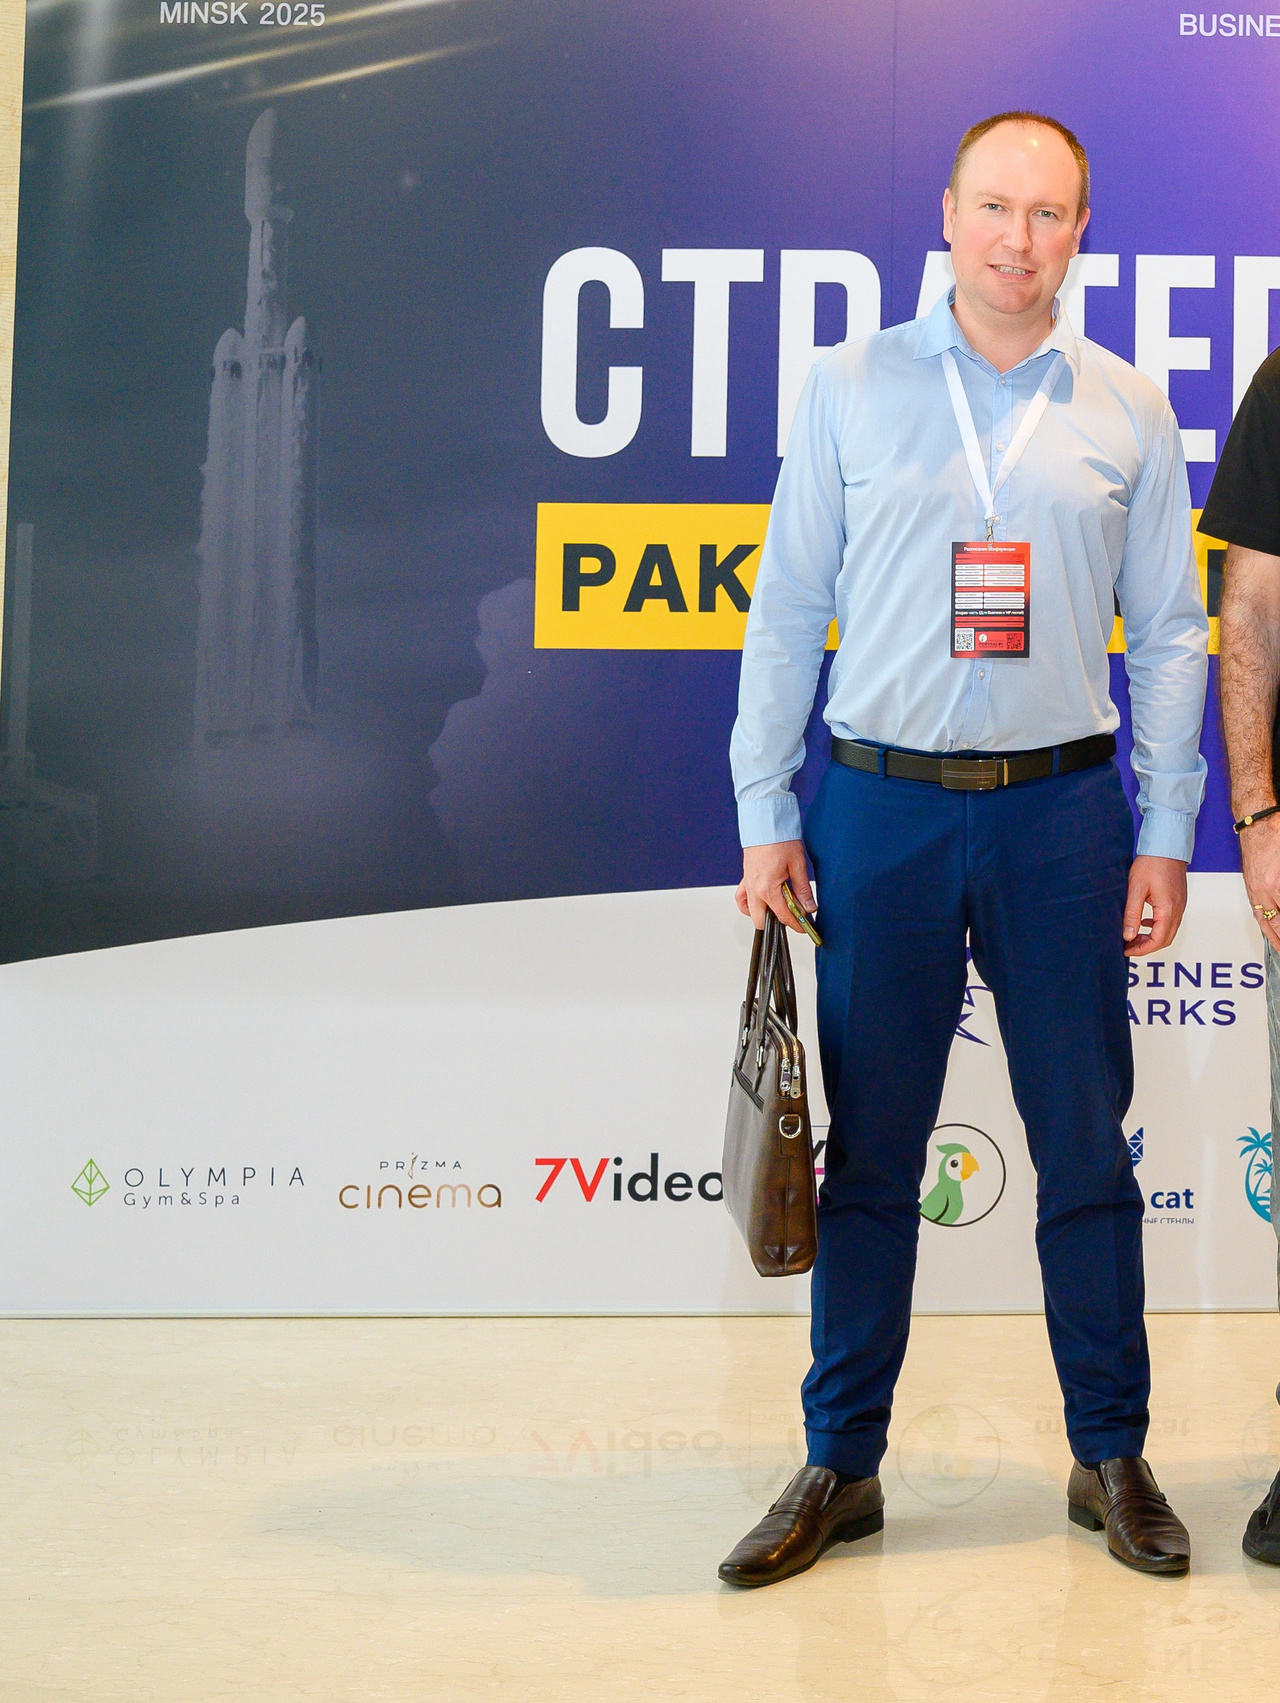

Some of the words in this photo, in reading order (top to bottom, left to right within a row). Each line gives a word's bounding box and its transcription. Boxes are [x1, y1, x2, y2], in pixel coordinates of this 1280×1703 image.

[160, 1, 248, 25] MINSK
[259, 2, 325, 26] 2025
[124, 1166, 305, 1188] OLYMPIA
[535, 1152, 723, 1203] 7Video
[123, 1192, 241, 1209] Gym&Spa
[338, 1183, 502, 1209] cinema
[1150, 1188, 1194, 1209] cat
